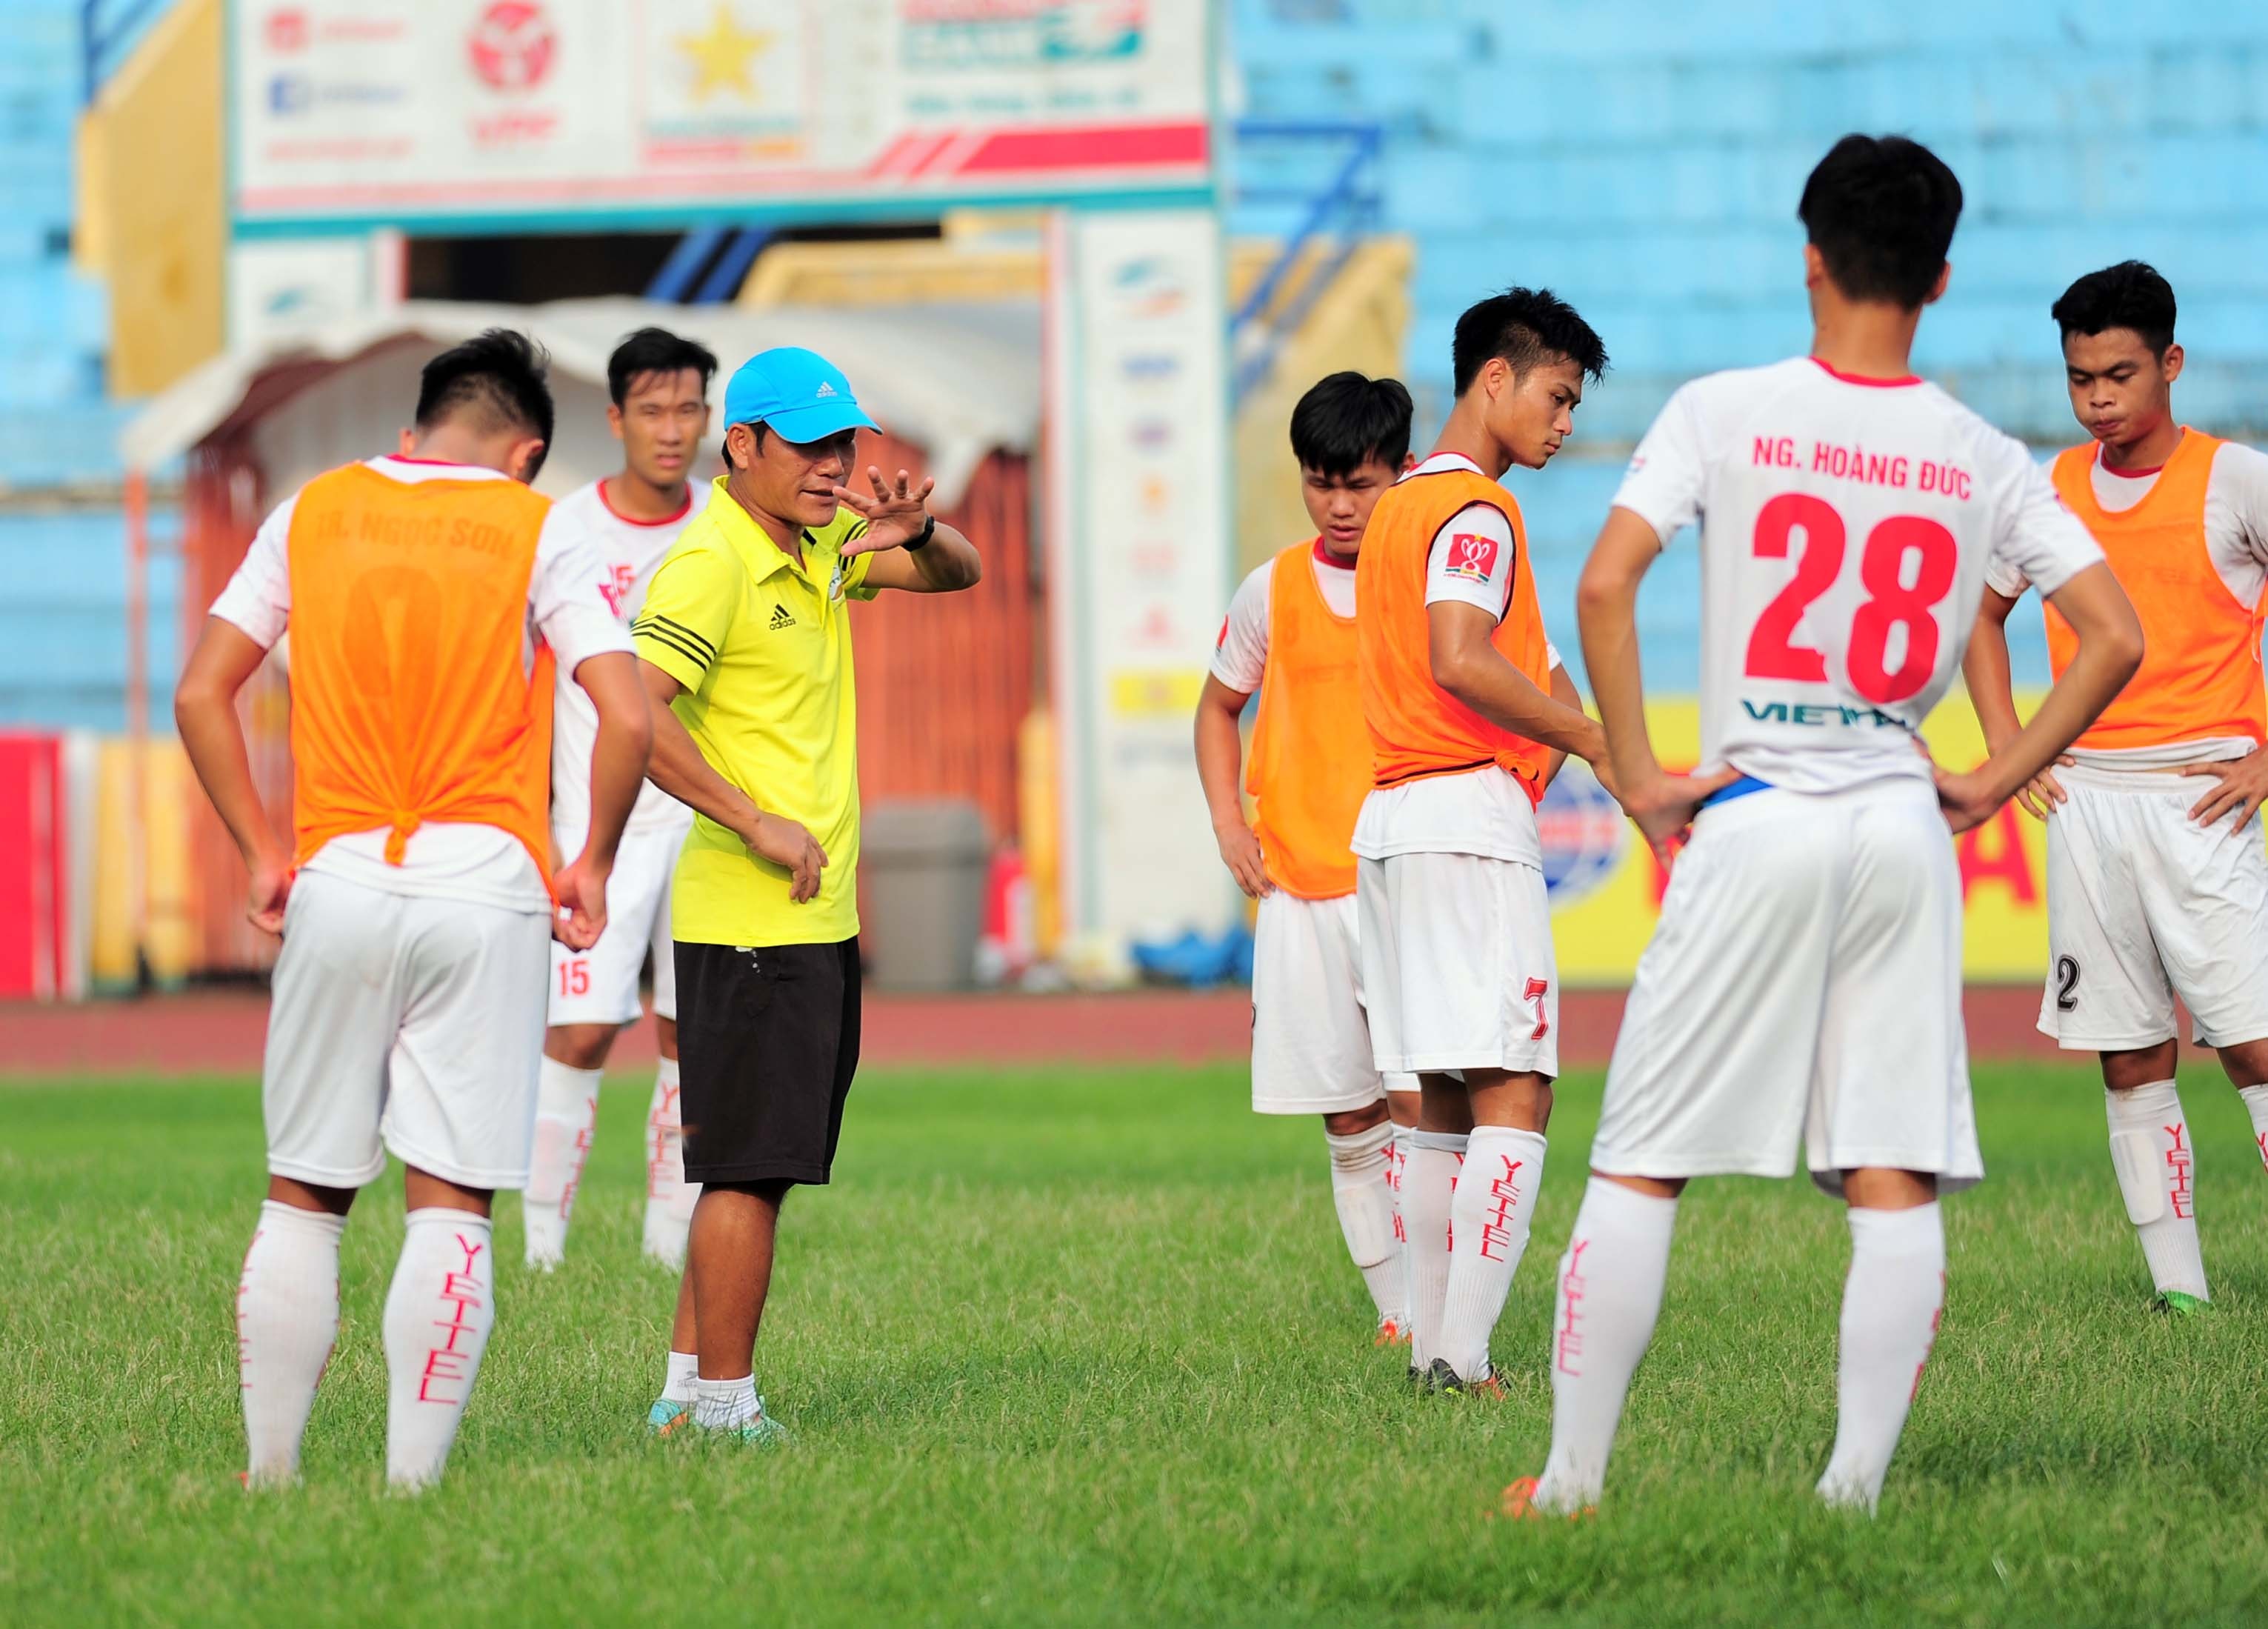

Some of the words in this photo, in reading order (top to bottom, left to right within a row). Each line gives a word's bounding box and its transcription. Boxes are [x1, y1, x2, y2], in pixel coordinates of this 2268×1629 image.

[1752, 436, 1801, 469] NG.
[1813, 442, 1908, 488] HOÀNG
[1918, 458, 1971, 502] ĐỨC
[769, 618, 796, 630] adidas
[1744, 492, 1958, 704] 28
[559, 961, 590, 996] 15
[1524, 976, 1550, 1039] 7
[2057, 954, 2081, 1013] 2
